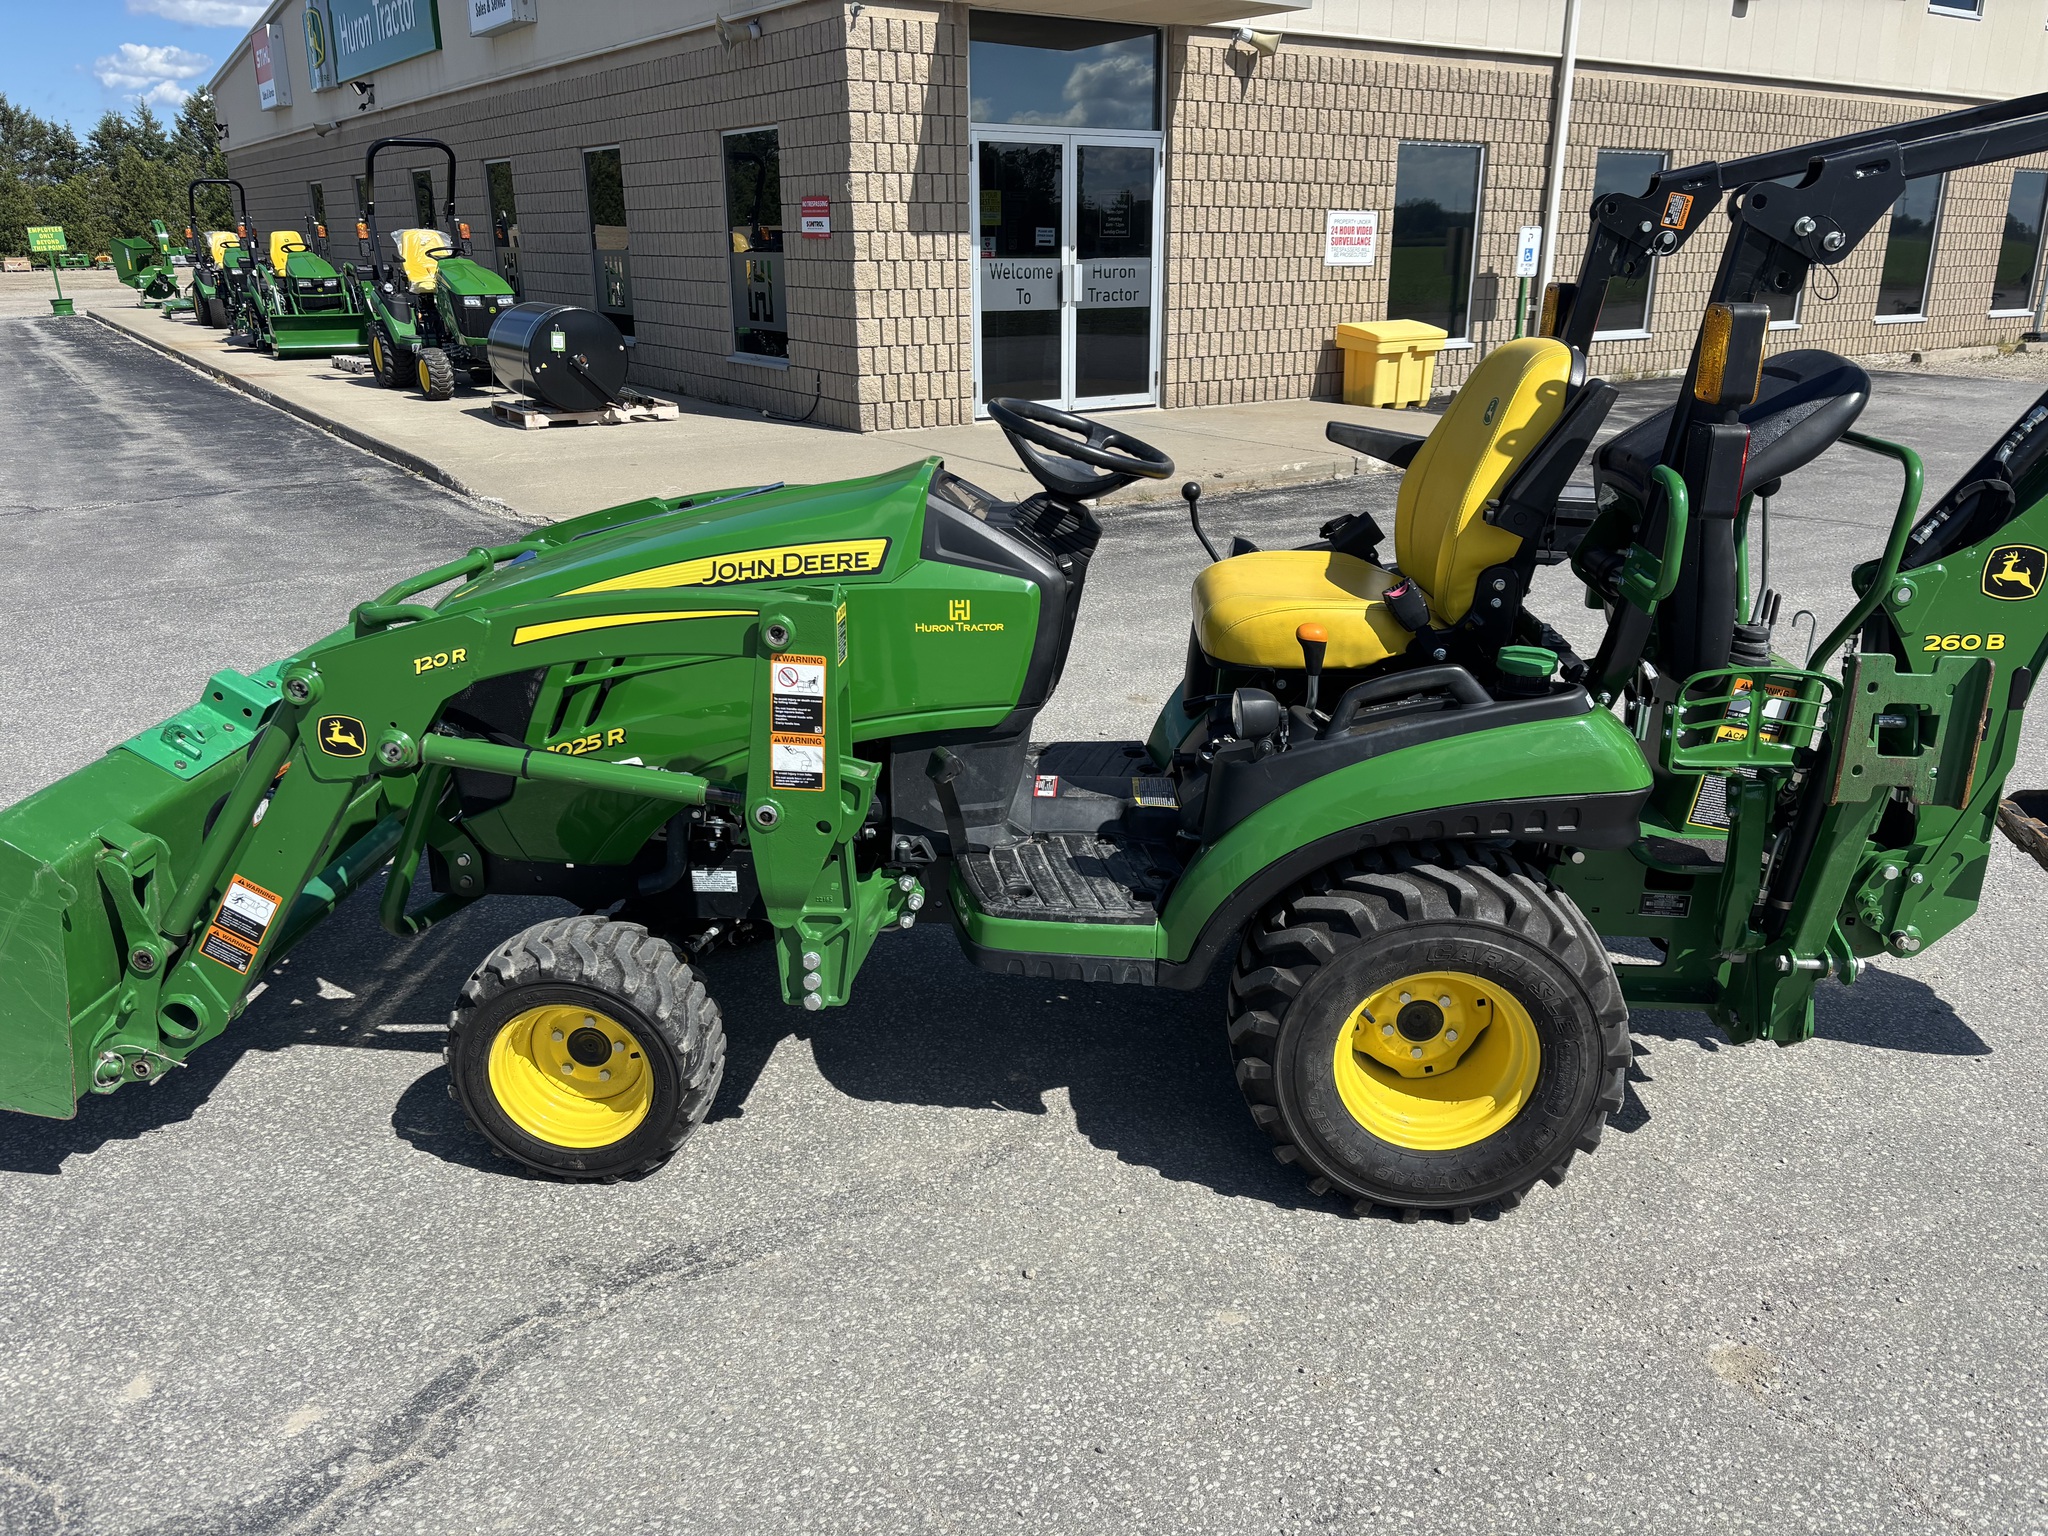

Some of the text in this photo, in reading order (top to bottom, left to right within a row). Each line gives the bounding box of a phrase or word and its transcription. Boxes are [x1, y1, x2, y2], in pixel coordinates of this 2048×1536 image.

[475, 2, 486, 17] Sales
[338, 0, 417, 56] Huron Tractor
[1331, 226, 1373, 235] 24 HOUR VIDEO
[1331, 237, 1371, 246] SURVEILLANCE
[989, 263, 1053, 280] Welcome
[1092, 264, 1136, 279] Huron
[1016, 288, 1032, 305] To
[1087, 287, 1140, 302] Tractor
[701, 551, 870, 583] JOHN DEERE
[915, 621, 1004, 633] HURON TRACTOR
[1922, 633, 2006, 652] 260 B
[413, 648, 467, 676] 120 R
[782, 655, 823, 665] WARNING
[607, 728, 625, 747] R
[781, 736, 822, 745] WARNING
[246, 882, 277, 901] WARNING
[221, 934, 252, 952] WARNING
[1427, 943, 1578, 1035] CARLISLE
